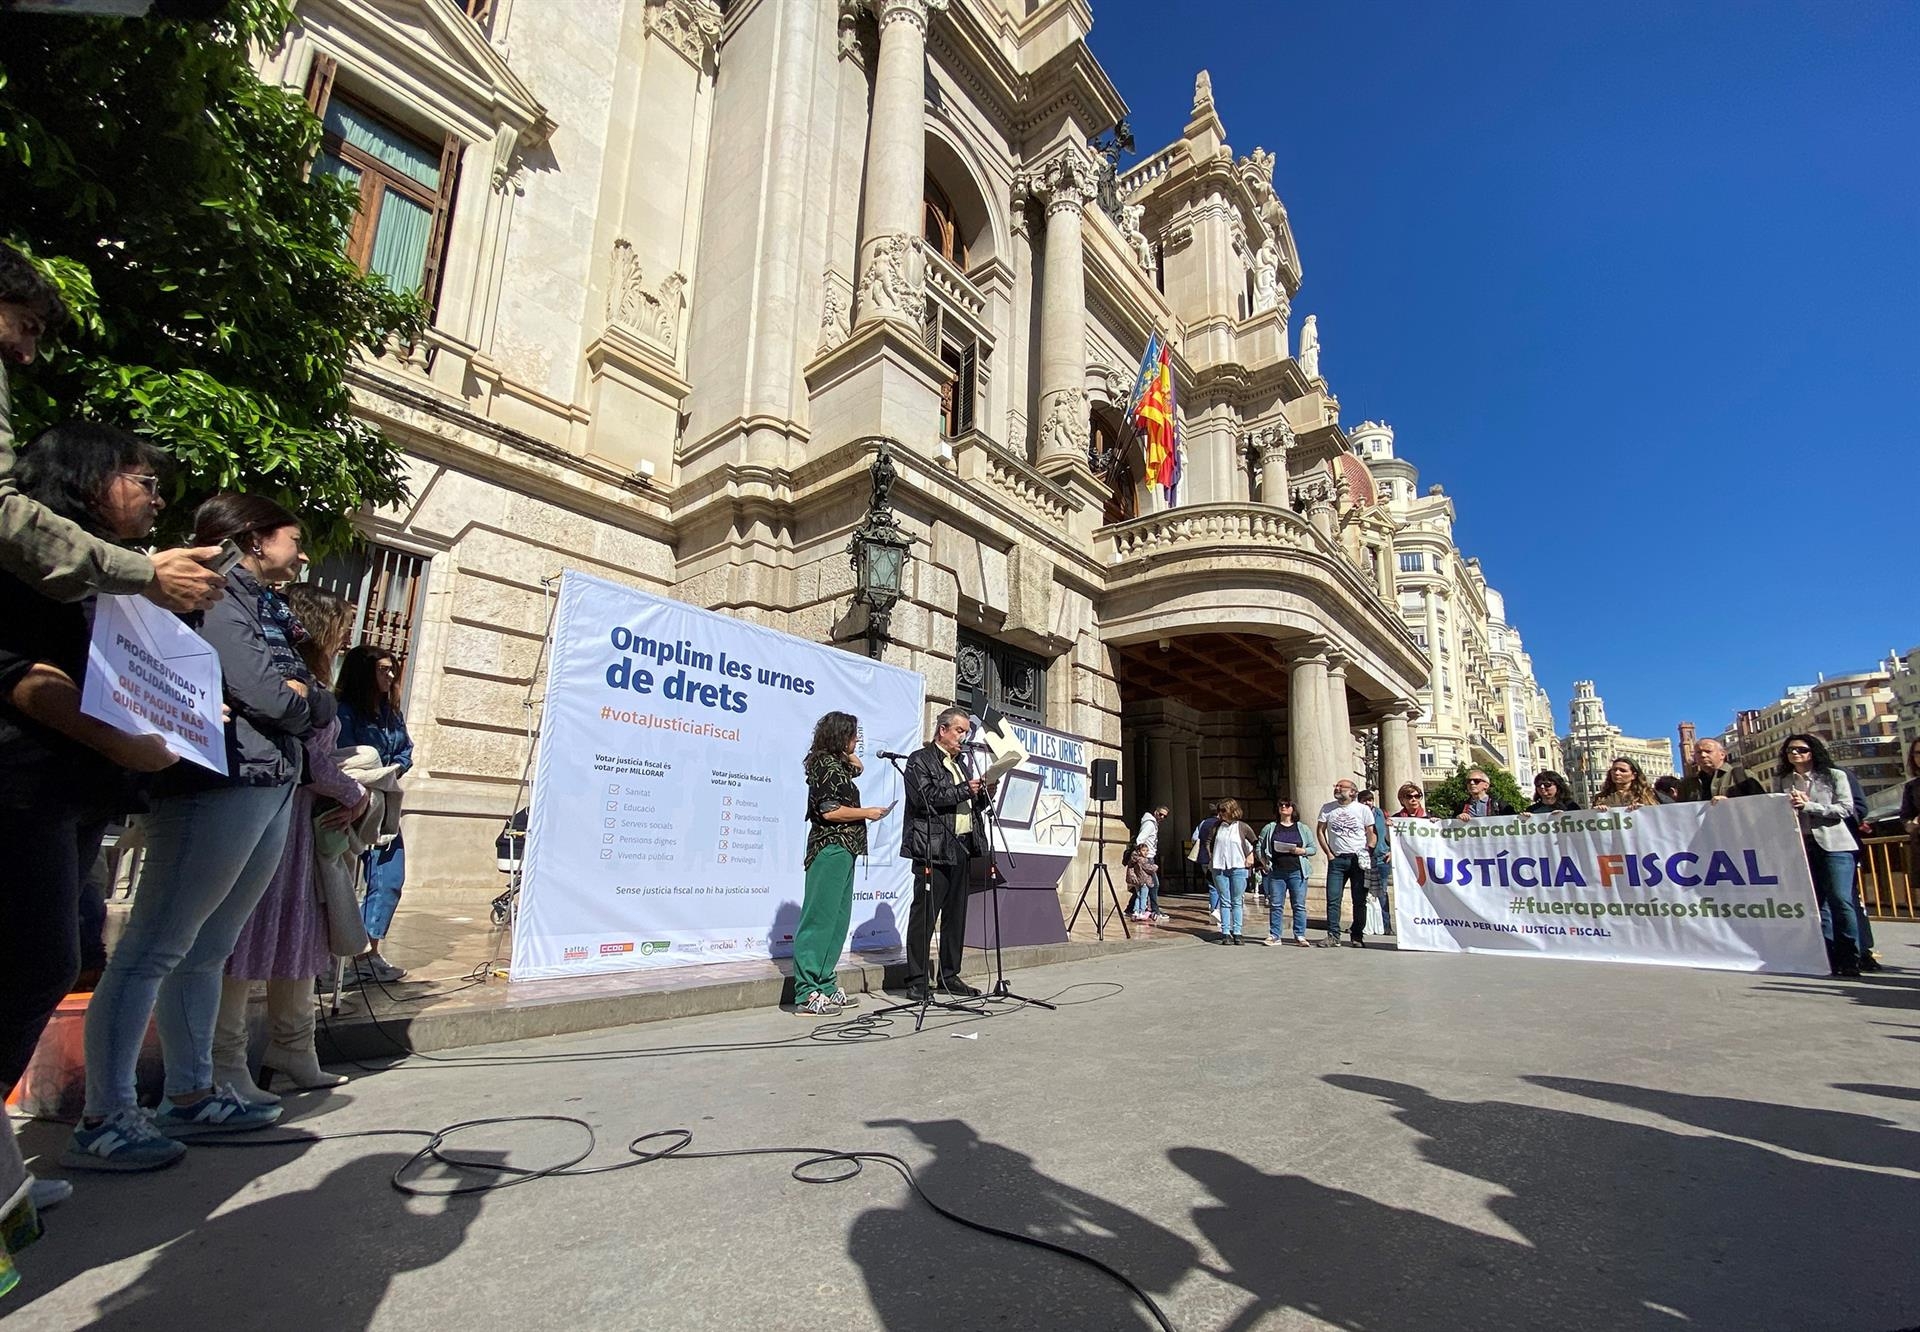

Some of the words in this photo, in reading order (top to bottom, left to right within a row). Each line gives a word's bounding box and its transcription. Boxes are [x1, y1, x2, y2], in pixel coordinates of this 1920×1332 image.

[116, 633, 197, 695] PROGRESIVIDAD
[199, 688, 206, 700] Y
[610, 626, 713, 671] Omplim
[719, 651, 753, 681] les
[758, 668, 815, 696] urnes
[128, 660, 195, 709] SOLIDARIDAD
[606, 656, 654, 695] de
[663, 671, 748, 714] drets
[118, 675, 141, 697] QUE
[143, 690, 178, 718] PAGUE
[181, 708, 204, 730] MÁS
[112, 690, 147, 719] QUIEN
[150, 711, 174, 733] MÁS
[177, 724, 209, 747] TIENE
[600, 705, 741, 742] #votaJustíciaFiscal
[1010, 726, 1038, 754] PLIM
[1041, 734, 1056, 758] LES
[1059, 739, 1083, 765] URNES
[594, 764, 614, 772] votar
[615, 766, 628, 774] per
[629, 767, 665, 777] MILLORAR
[595, 754, 616, 763] Votar
[644, 760, 663, 769] fiscal
[663, 762, 672, 770] és
[711, 769, 728, 777] Votar
[750, 774, 765, 782] fiscal
[1051, 768, 1076, 794] DRETS
[625, 787, 651, 797] Sanitat
[623, 803, 656, 813] Educació
[621, 819, 648, 829] Serveis
[649, 821, 673, 830] socials
[747, 827, 762, 836] fiscal
[1393, 811, 1633, 840] #foraparadisosfiscals
[619, 835, 652, 845] Pensions
[653, 837, 677, 847] dignes
[618, 852, 646, 860] Vivenda
[1415, 849, 1587, 888] JUSTÍCIA
[1598, 849, 1778, 888] FISCAL
[615, 886, 641, 895] Sense
[673, 886, 693, 895] fiscal
[705, 886, 714, 894] hi
[714, 886, 724, 894] ha
[750, 886, 770, 894] social
[852, 890, 874, 900] STÍCIA
[875, 890, 898, 900] FISCAL
[1509, 896, 1805, 919] #fueraparaísosfiscales
[1413, 917, 1471, 928] CAMPANYA
[1472, 921, 1491, 931] PER
[1493, 923, 1518, 933] UNA
[1521, 923, 1566, 936] JUSTÍCIA
